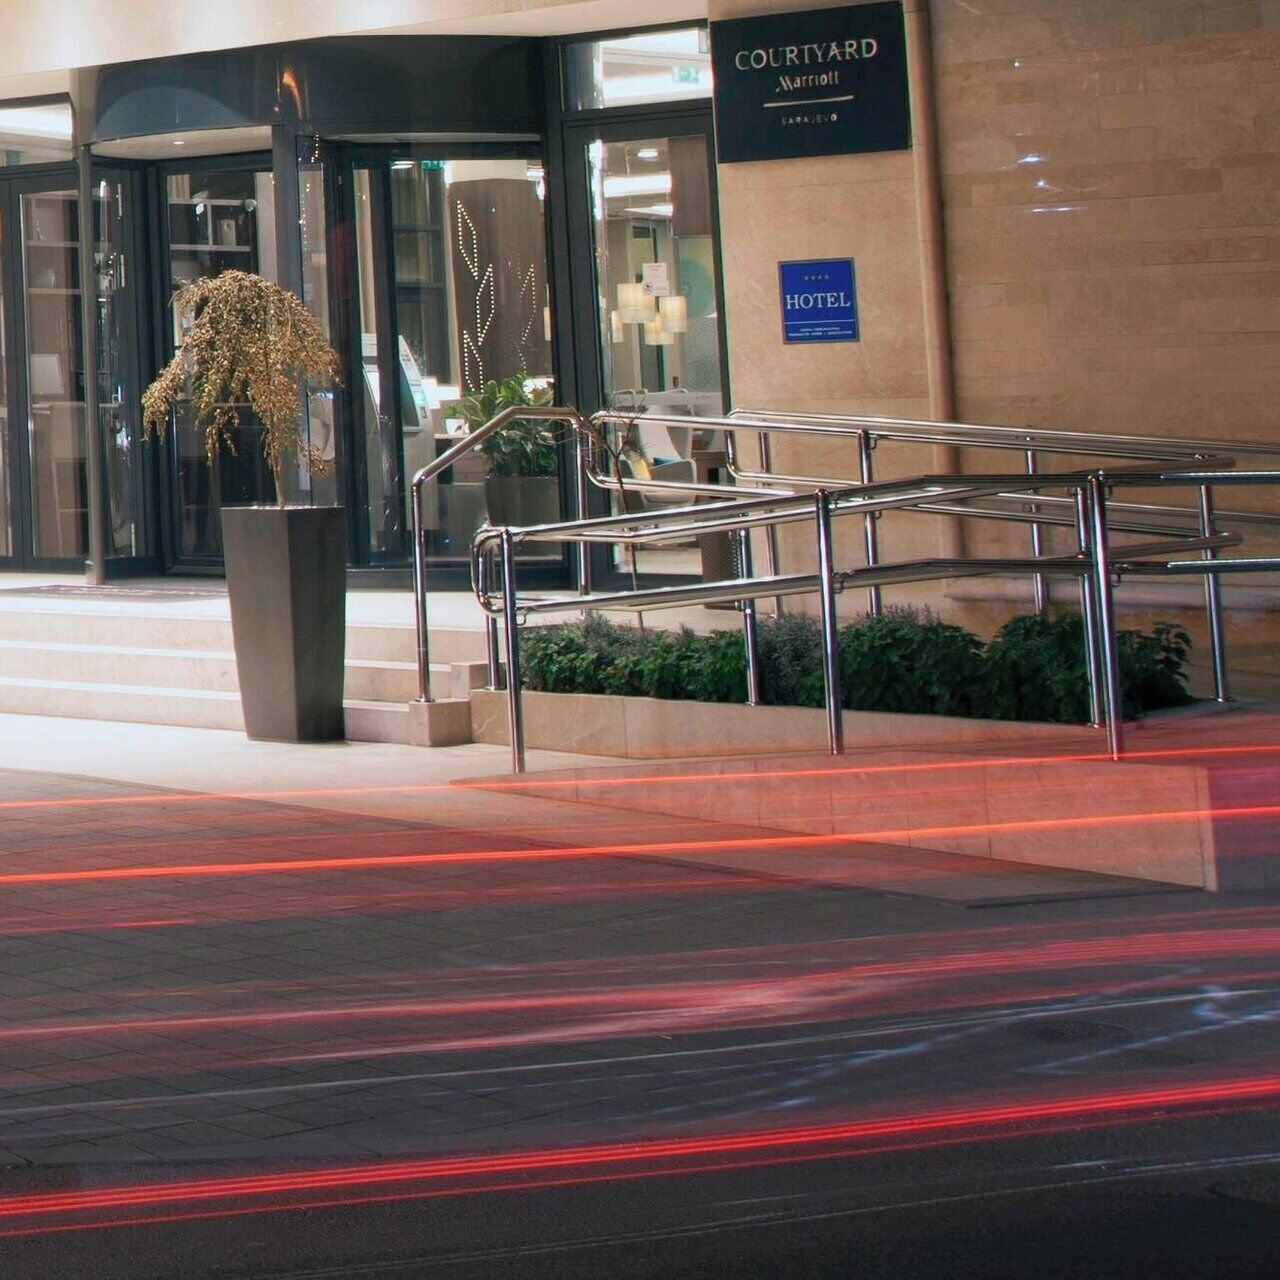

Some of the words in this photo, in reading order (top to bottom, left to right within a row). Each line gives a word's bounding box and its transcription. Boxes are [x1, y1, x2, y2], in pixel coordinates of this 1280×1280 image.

[735, 38, 880, 71] COURTYARD
[774, 70, 840, 94] Marriott
[785, 292, 851, 310] HOTEL
